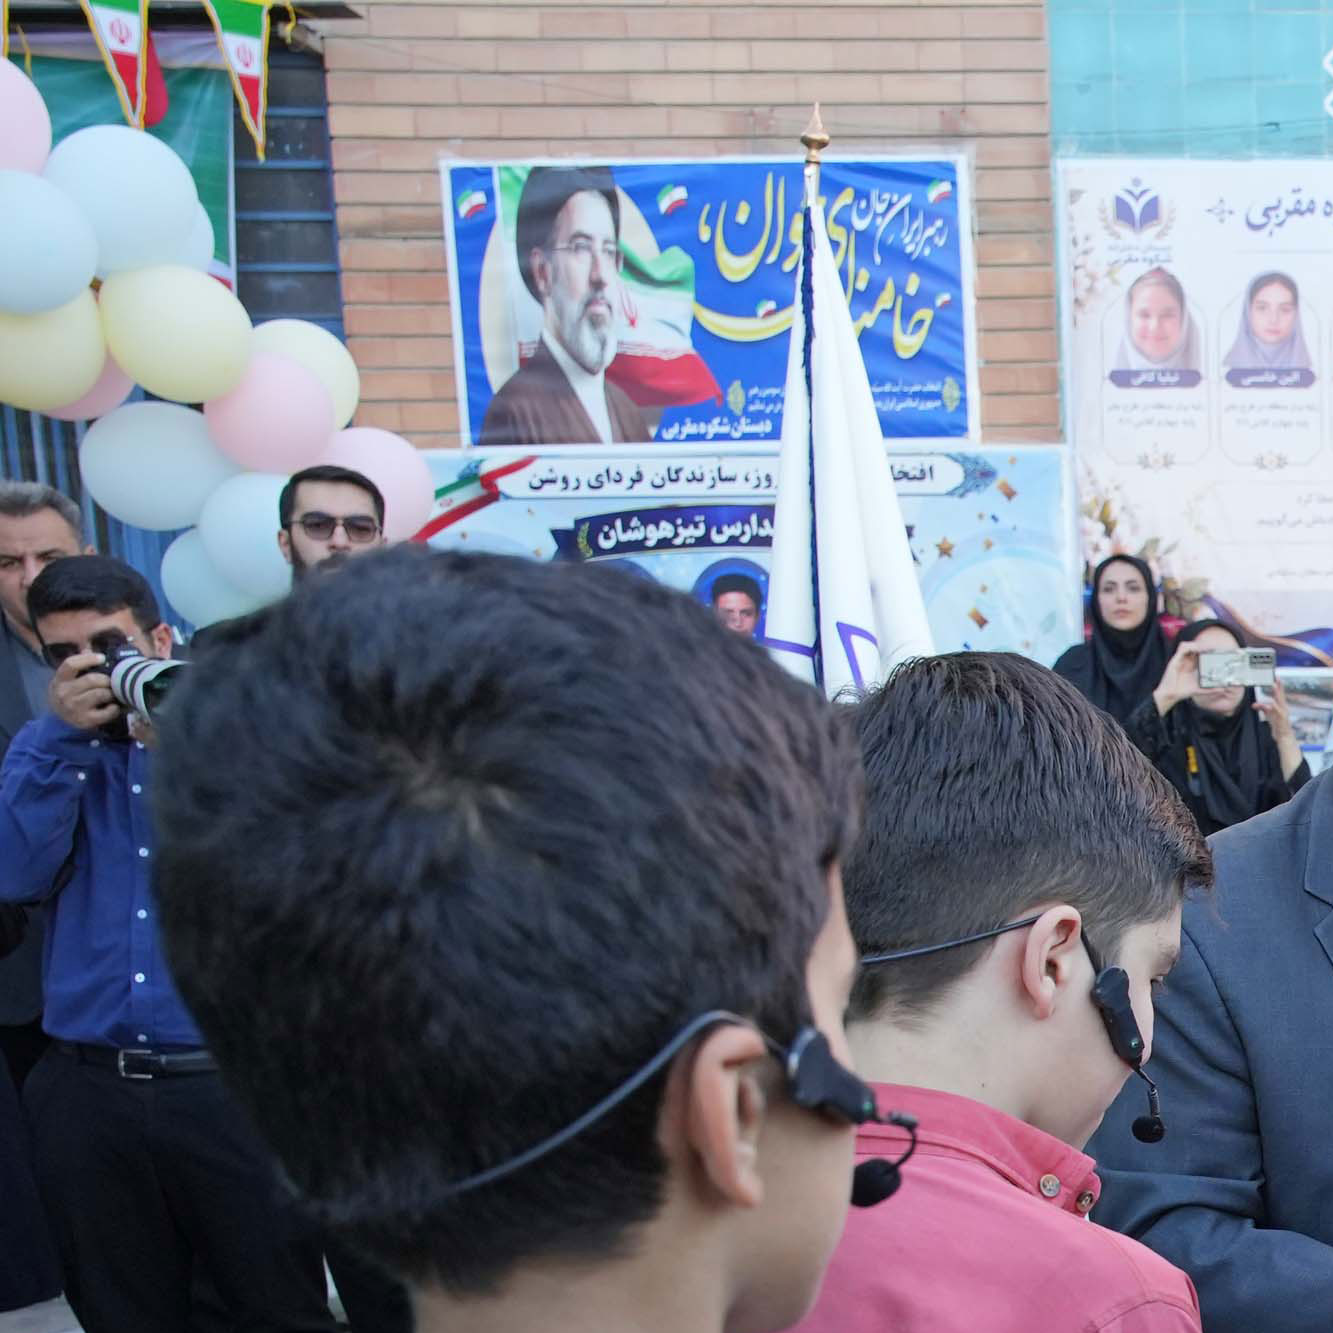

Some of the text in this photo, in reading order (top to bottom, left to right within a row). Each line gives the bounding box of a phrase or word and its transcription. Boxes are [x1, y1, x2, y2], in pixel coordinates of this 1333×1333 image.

[1245, 187, 1316, 238] مقربی
[528, 468, 581, 492] روشن
[587, 467, 644, 491] فردای
[651, 466, 737, 490] سازندگان
[597, 514, 707, 549] تیزهوشان
